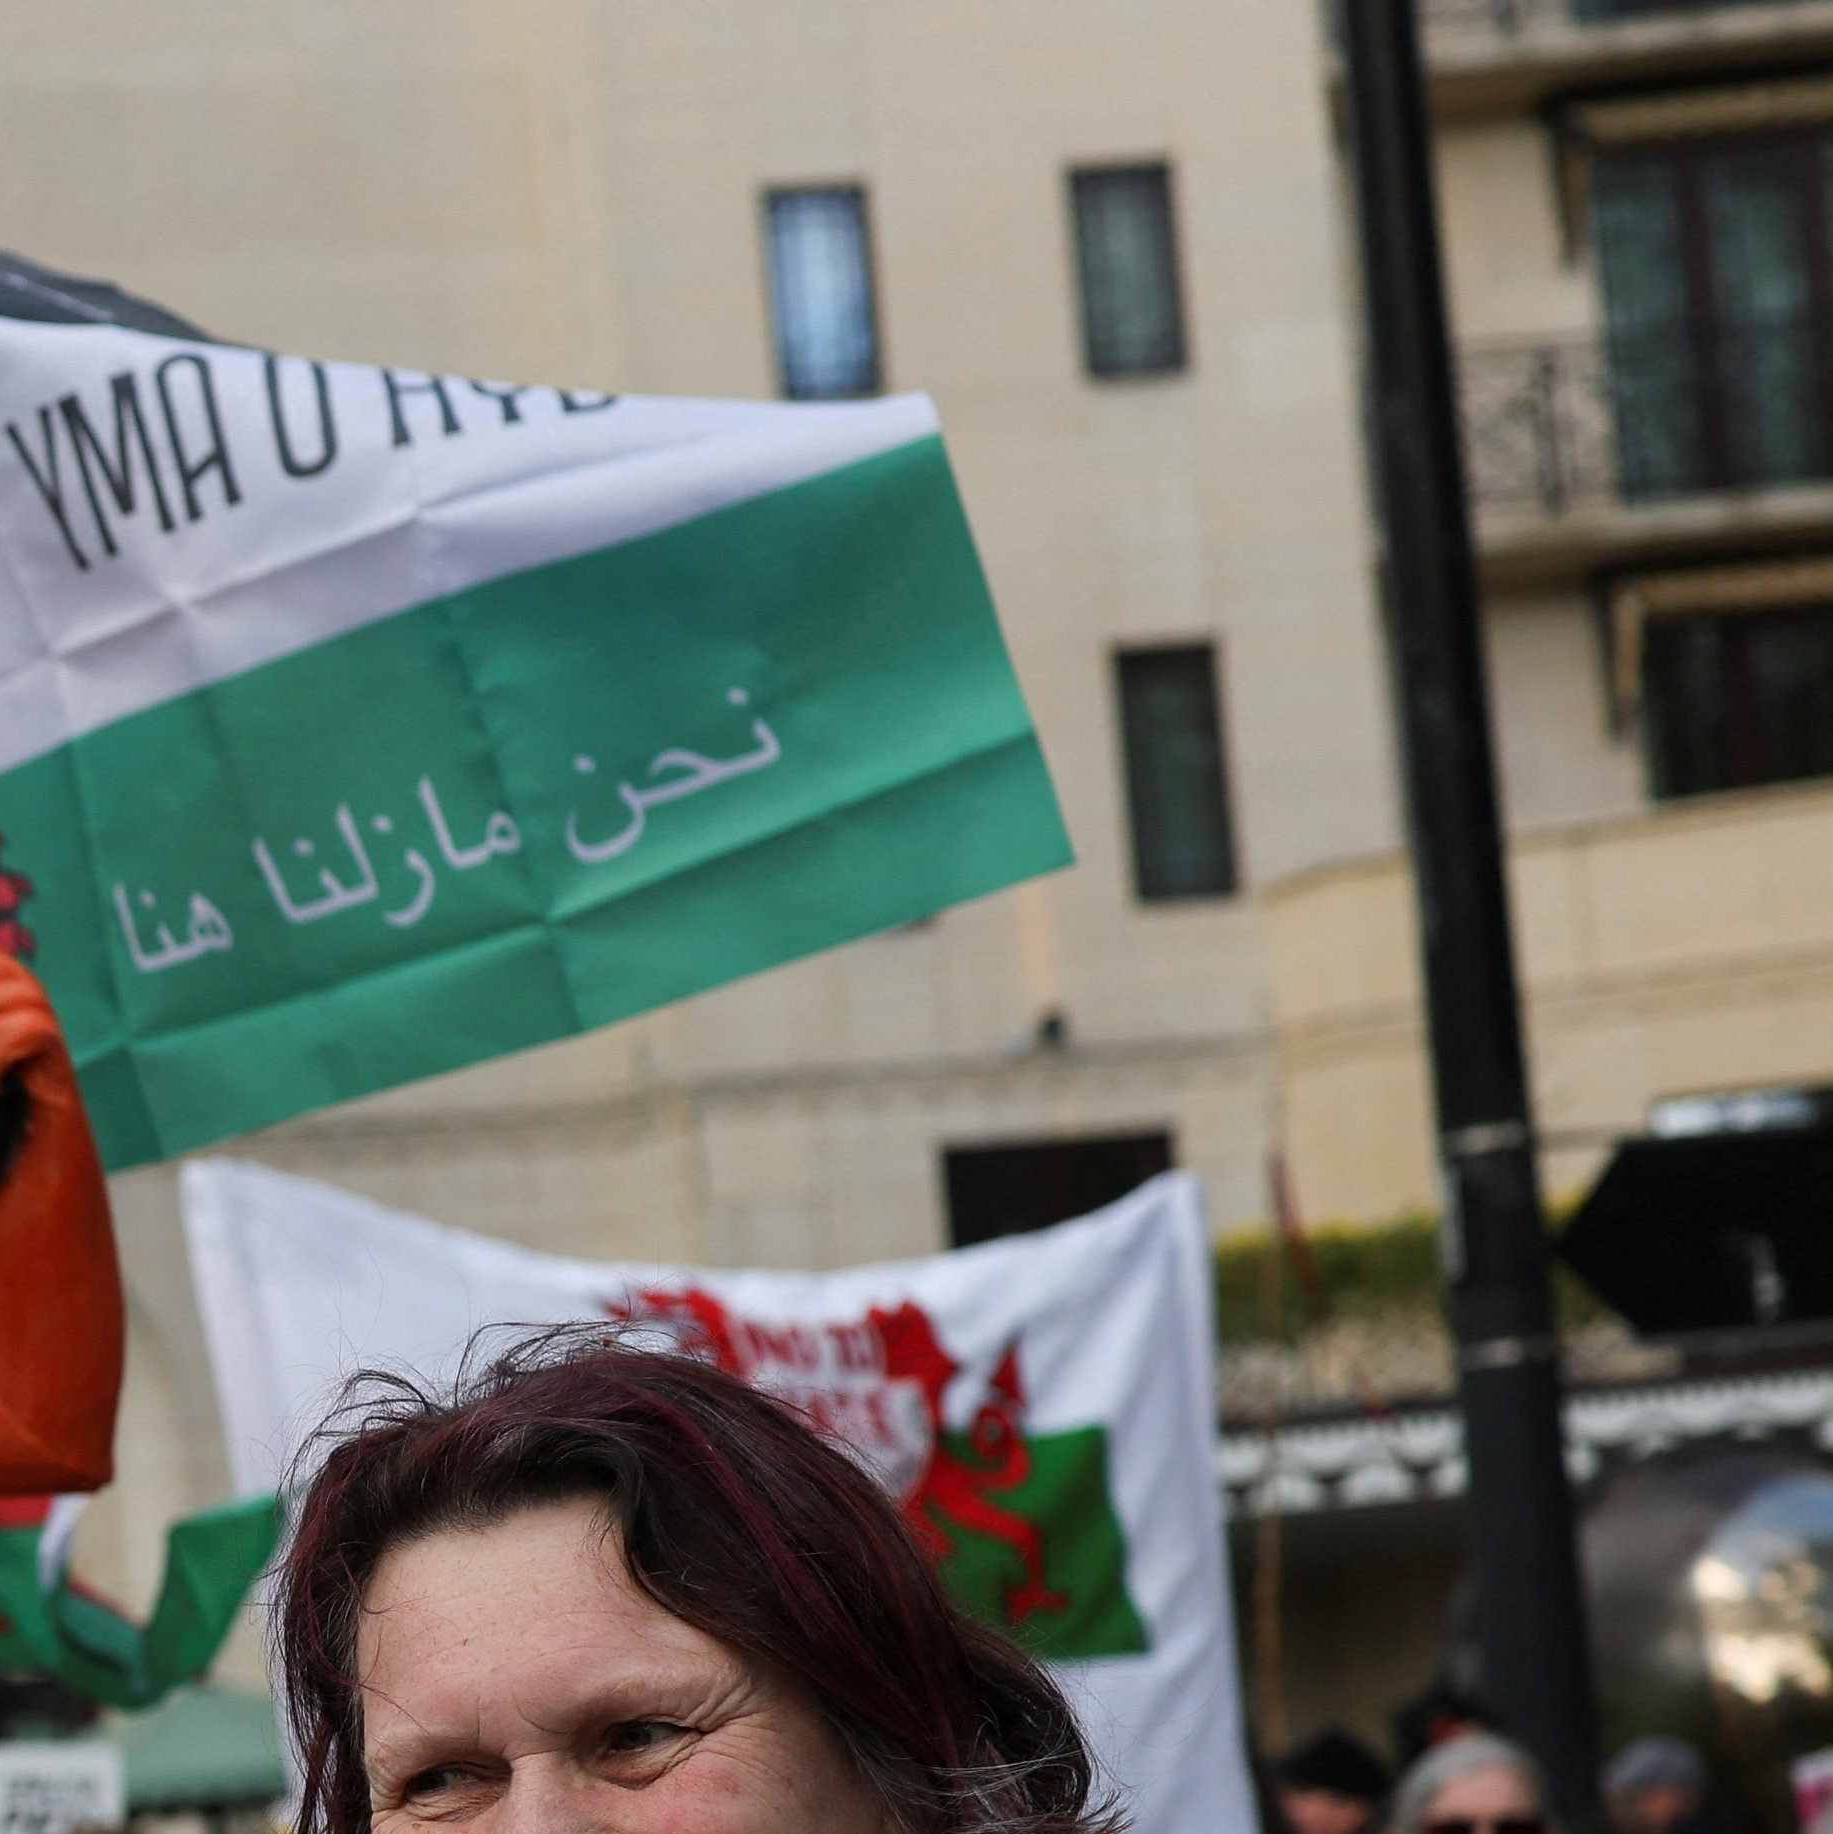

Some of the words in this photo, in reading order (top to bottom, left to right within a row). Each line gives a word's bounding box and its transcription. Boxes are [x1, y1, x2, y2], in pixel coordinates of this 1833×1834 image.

[4, 351, 243, 572] YMA
[564, 686, 782, 864] نحن
[112, 880, 233, 973] هنا
